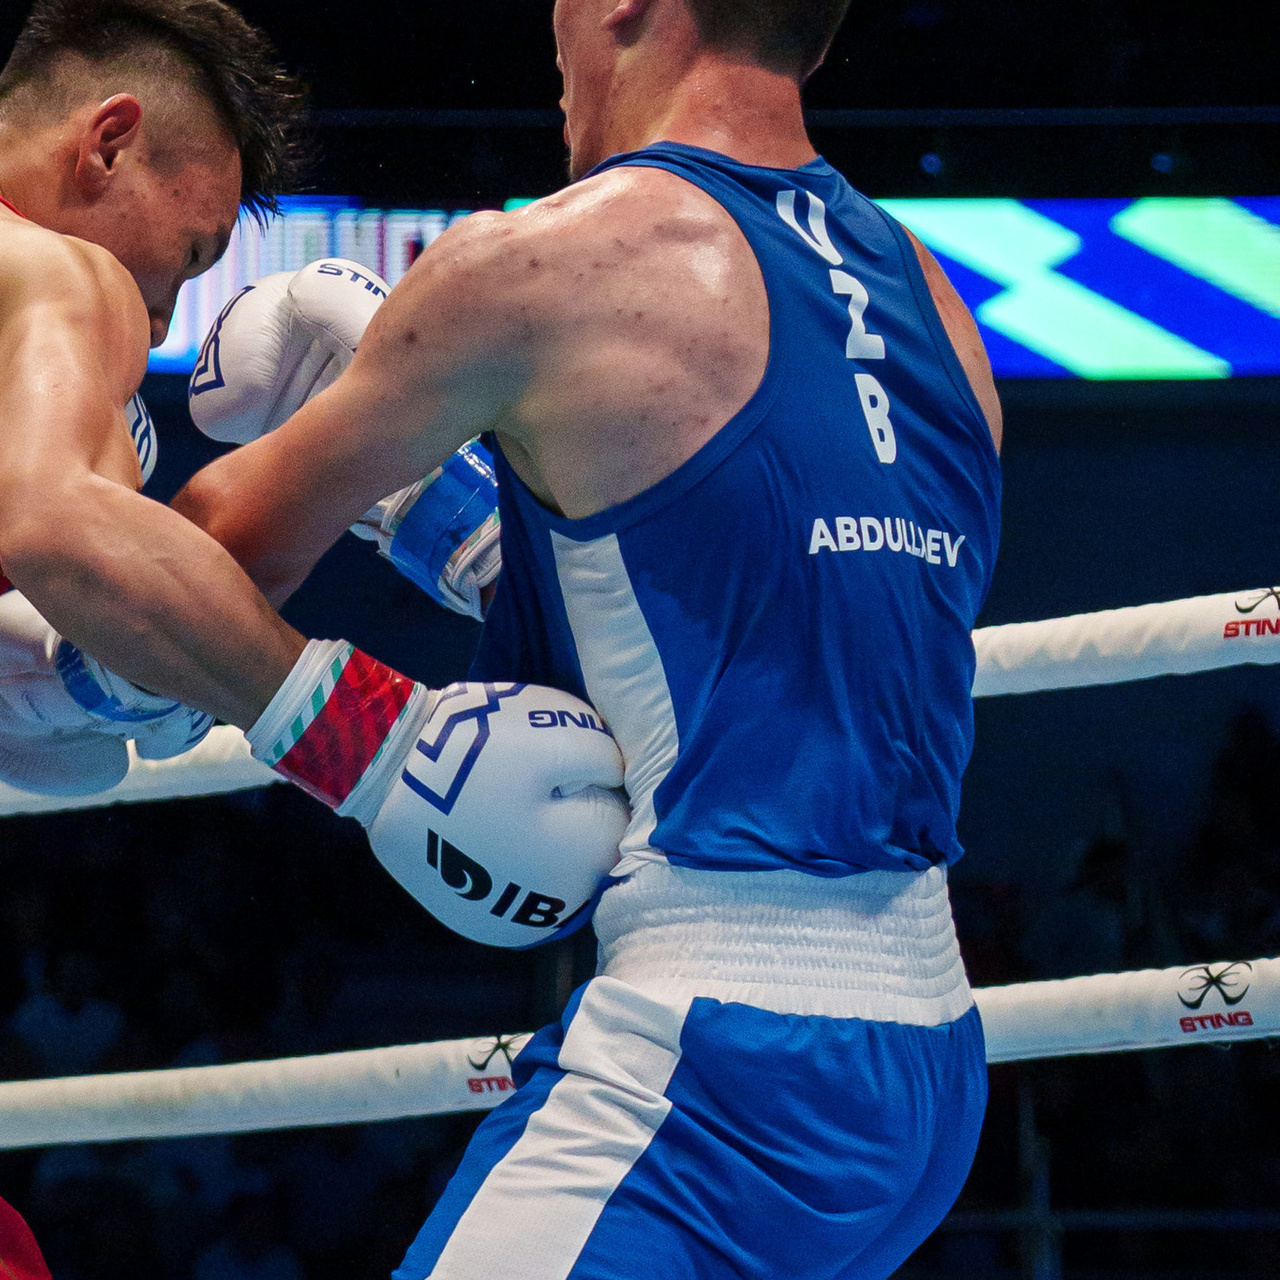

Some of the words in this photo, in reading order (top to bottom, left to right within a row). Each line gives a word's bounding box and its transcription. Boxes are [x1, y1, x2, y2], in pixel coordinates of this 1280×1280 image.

[1223, 617, 1280, 639] STIN
[489, 880, 591, 929] IB
[1179, 1010, 1254, 1033] STING
